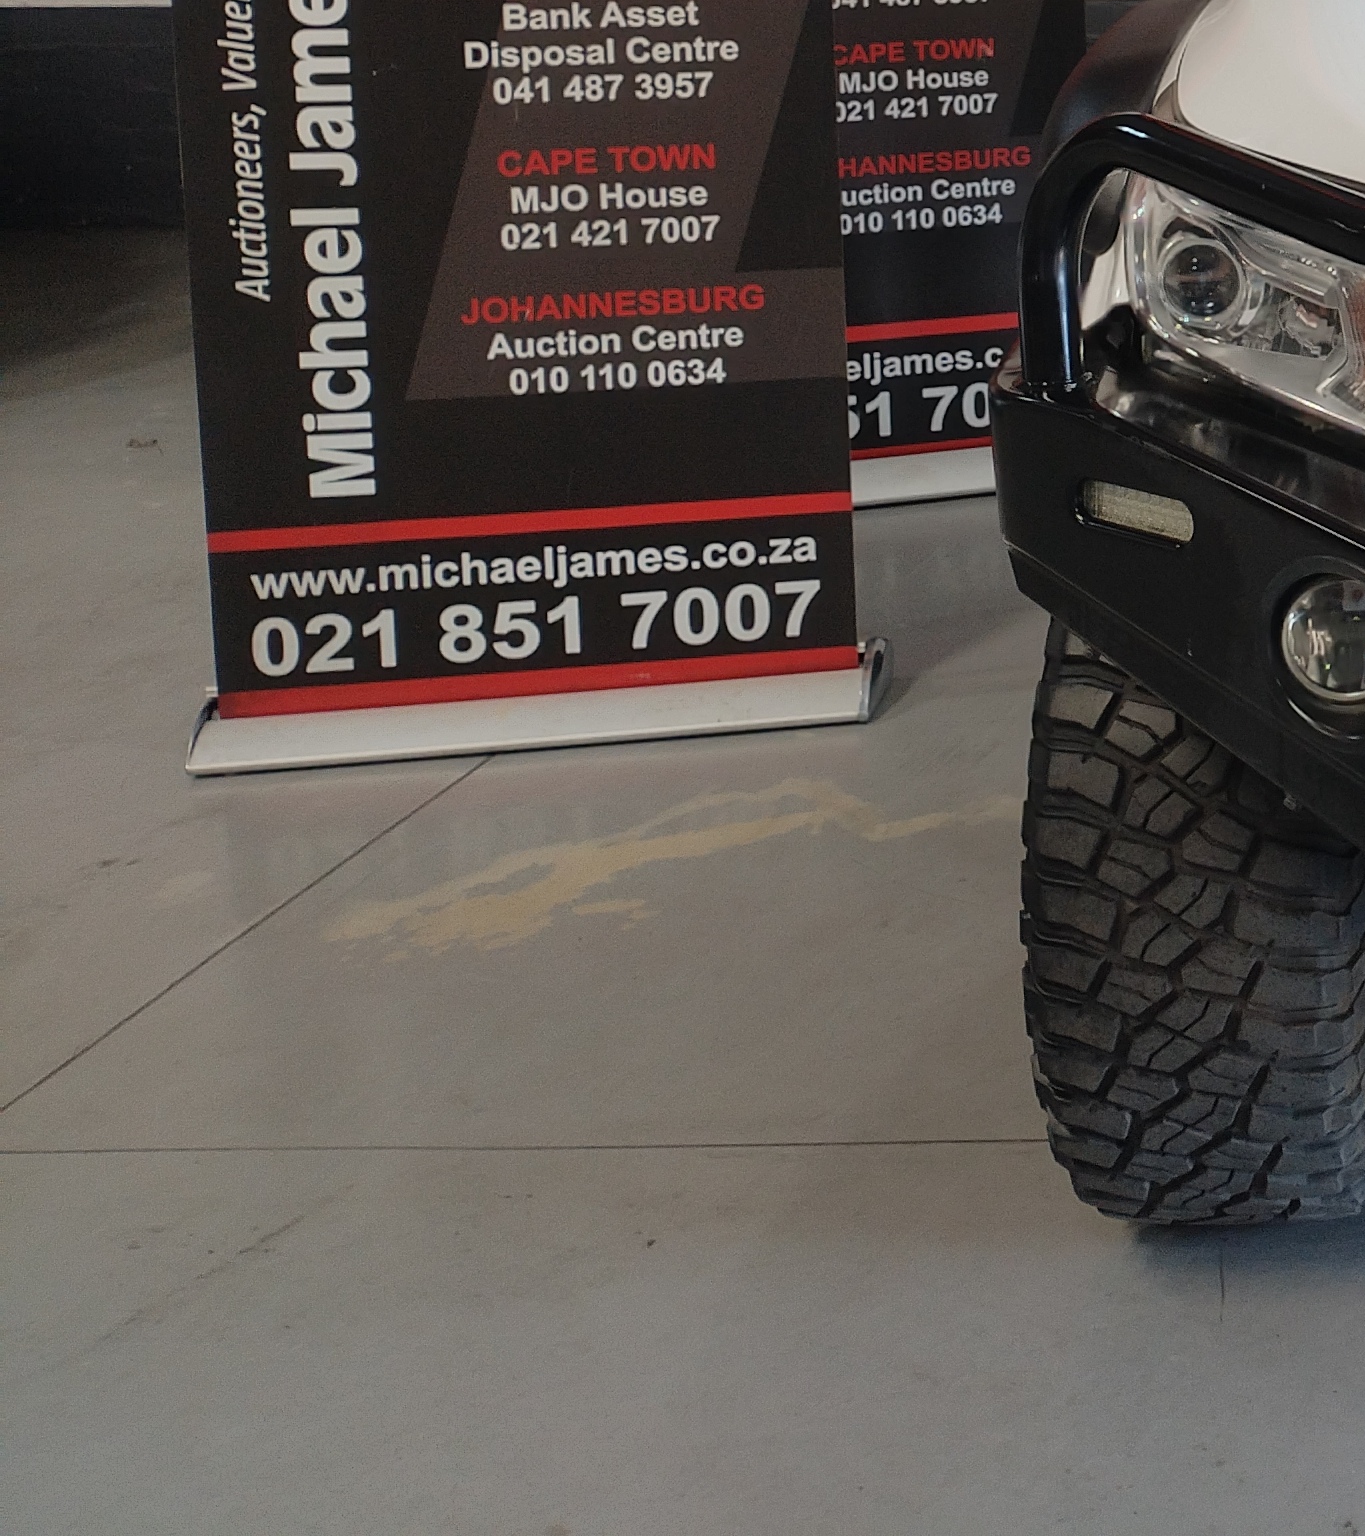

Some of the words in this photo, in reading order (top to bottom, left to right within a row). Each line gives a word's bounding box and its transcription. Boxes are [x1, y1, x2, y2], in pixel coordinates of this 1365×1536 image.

[502, 1, 593, 32] Bank
[599, 0, 700, 28] Asset
[463, 37, 616, 74] Disposal
[625, 35, 740, 64] Centre
[833, 42, 906, 66] CAPE
[911, 37, 995, 62] TOWN
[492, 75, 551, 105] 041
[562, 73, 624, 103] 487
[634, 70, 714, 100] 3957
[838, 69, 899, 95] MJO
[906, 68, 989, 90] House
[884, 96, 929, 120] 421
[937, 92, 999, 117] 7007
[496, 147, 598, 178] CAPE
[607, 143, 717, 173] TOWN
[838, 146, 1031, 178] HANNESBURG
[228, 103, 271, 303] Auctioneers,
[510, 183, 589, 215] MJO
[599, 182, 709, 210] House
[841, 183, 923, 206] uction
[930, 177, 1016, 200] Centre
[500, 221, 558, 251] 021
[570, 218, 628, 247] 421
[640, 214, 721, 244] 7007
[890, 207, 935, 231] 110
[941, 202, 1003, 228] 0634
[460, 283, 765, 326] JOHANNESBURG
[289, 207, 377, 499] Michael
[486, 329, 622, 361] Auction
[631, 323, 744, 352] Centre
[509, 365, 570, 396] 010
[580, 361, 638, 392] 110
[647, 357, 727, 388] 0634
[847, 347, 1003, 385] eljames.c
[922, 382, 991, 432] 70
[251, 533, 819, 601] www.michaeljames.co.za
[251, 608, 398, 677] 021
[439, 595, 581, 664] 851
[620, 579, 821, 650] 7007
